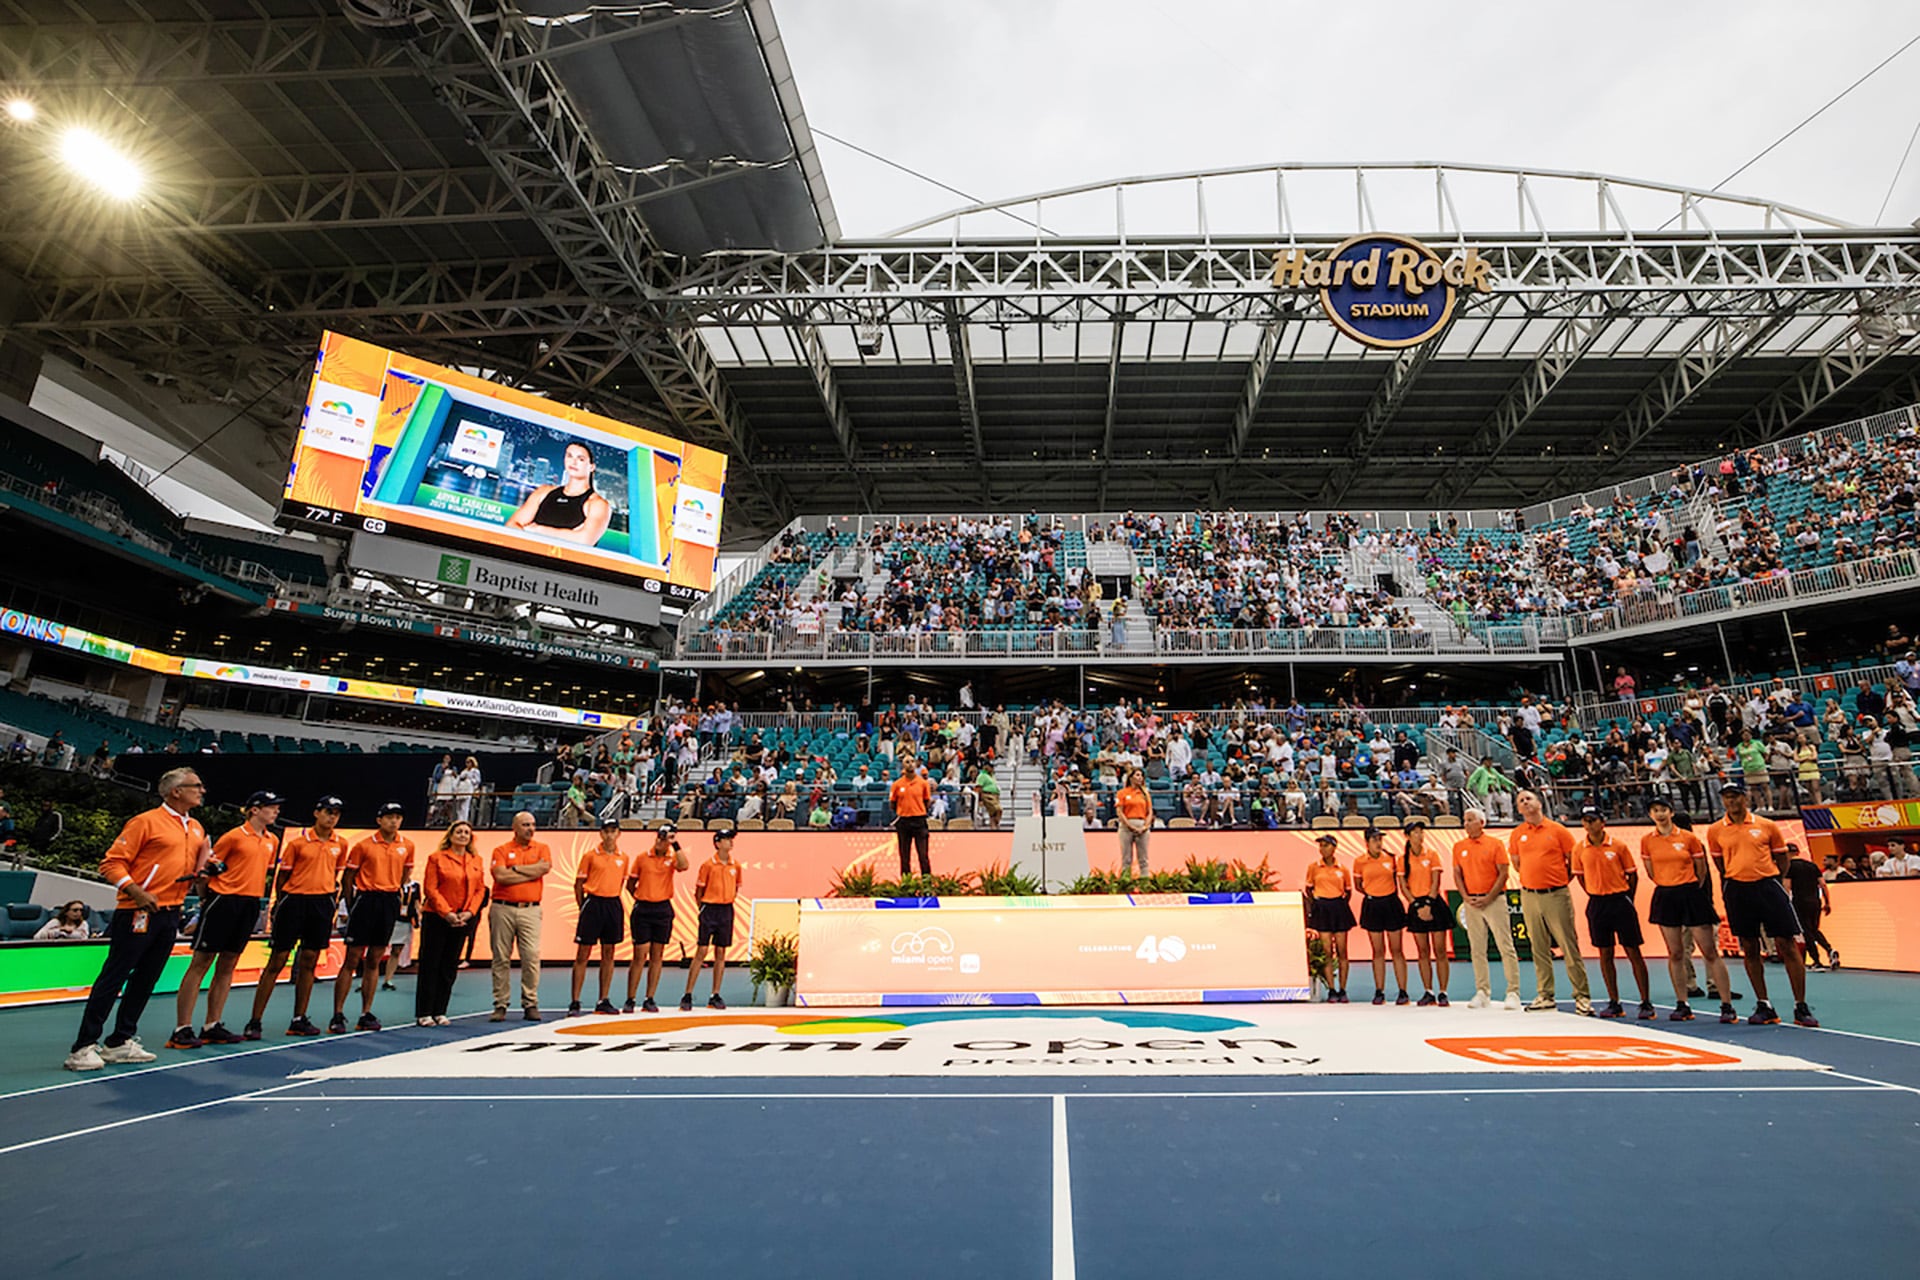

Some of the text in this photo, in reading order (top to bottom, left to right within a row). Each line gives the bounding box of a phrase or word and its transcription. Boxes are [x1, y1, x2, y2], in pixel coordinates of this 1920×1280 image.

[1272, 248, 1493, 295] Hard Rock
[1351, 303, 1429, 317] STADIUM
[332, 512, 343, 524] F
[365, 519, 384, 532] CC
[475, 566, 600, 606] Baptist Health
[670, 585, 692, 598] 5:47
[323, 607, 413, 630] SUPER BOWL VII
[470, 631, 622, 665] 1972 PERFECT SEASON TEAM 17-0
[253, 672, 278, 681] miami
[447, 697, 558, 718] www.MiamiOpen.com
[1078, 944, 1133, 953] CELEBRATING
[1135, 935, 1187, 964] 40
[892, 953, 926, 964] miami
[927, 955, 954, 966] open
[462, 1037, 1297, 1054] miami open
[943, 1056, 1321, 1067] presented by
